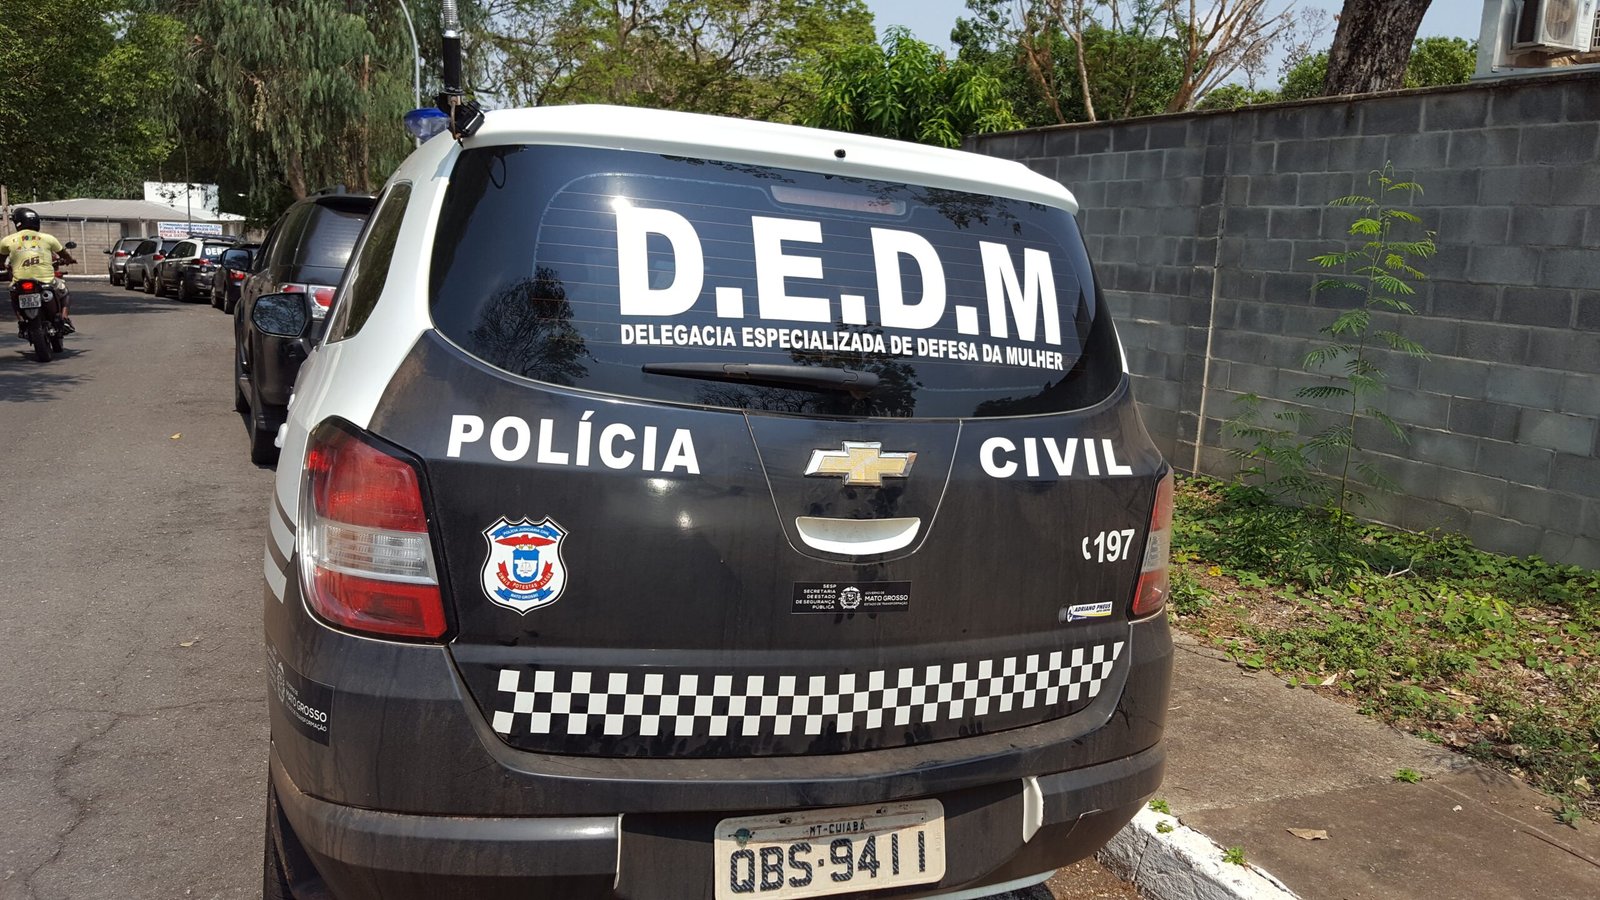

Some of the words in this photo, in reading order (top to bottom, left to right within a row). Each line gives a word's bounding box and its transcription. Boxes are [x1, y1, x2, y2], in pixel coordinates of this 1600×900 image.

[615, 206, 1062, 345] D.E.D.M
[620, 323, 737, 347] DELEGACIA
[742, 327, 887, 354] ESPECIALIZADA
[890, 336, 914, 356] DE
[917, 337, 979, 362] DEFESA
[982, 344, 1003, 364] DA
[1006, 346, 1064, 371] MULHER
[446, 410, 701, 475] POLÍCIA
[979, 436, 1133, 479] CIVIL
[1093, 528, 1136, 563] 197
[883, 594, 908, 602] GROSSO
[296, 700, 327, 723] GROSSO
